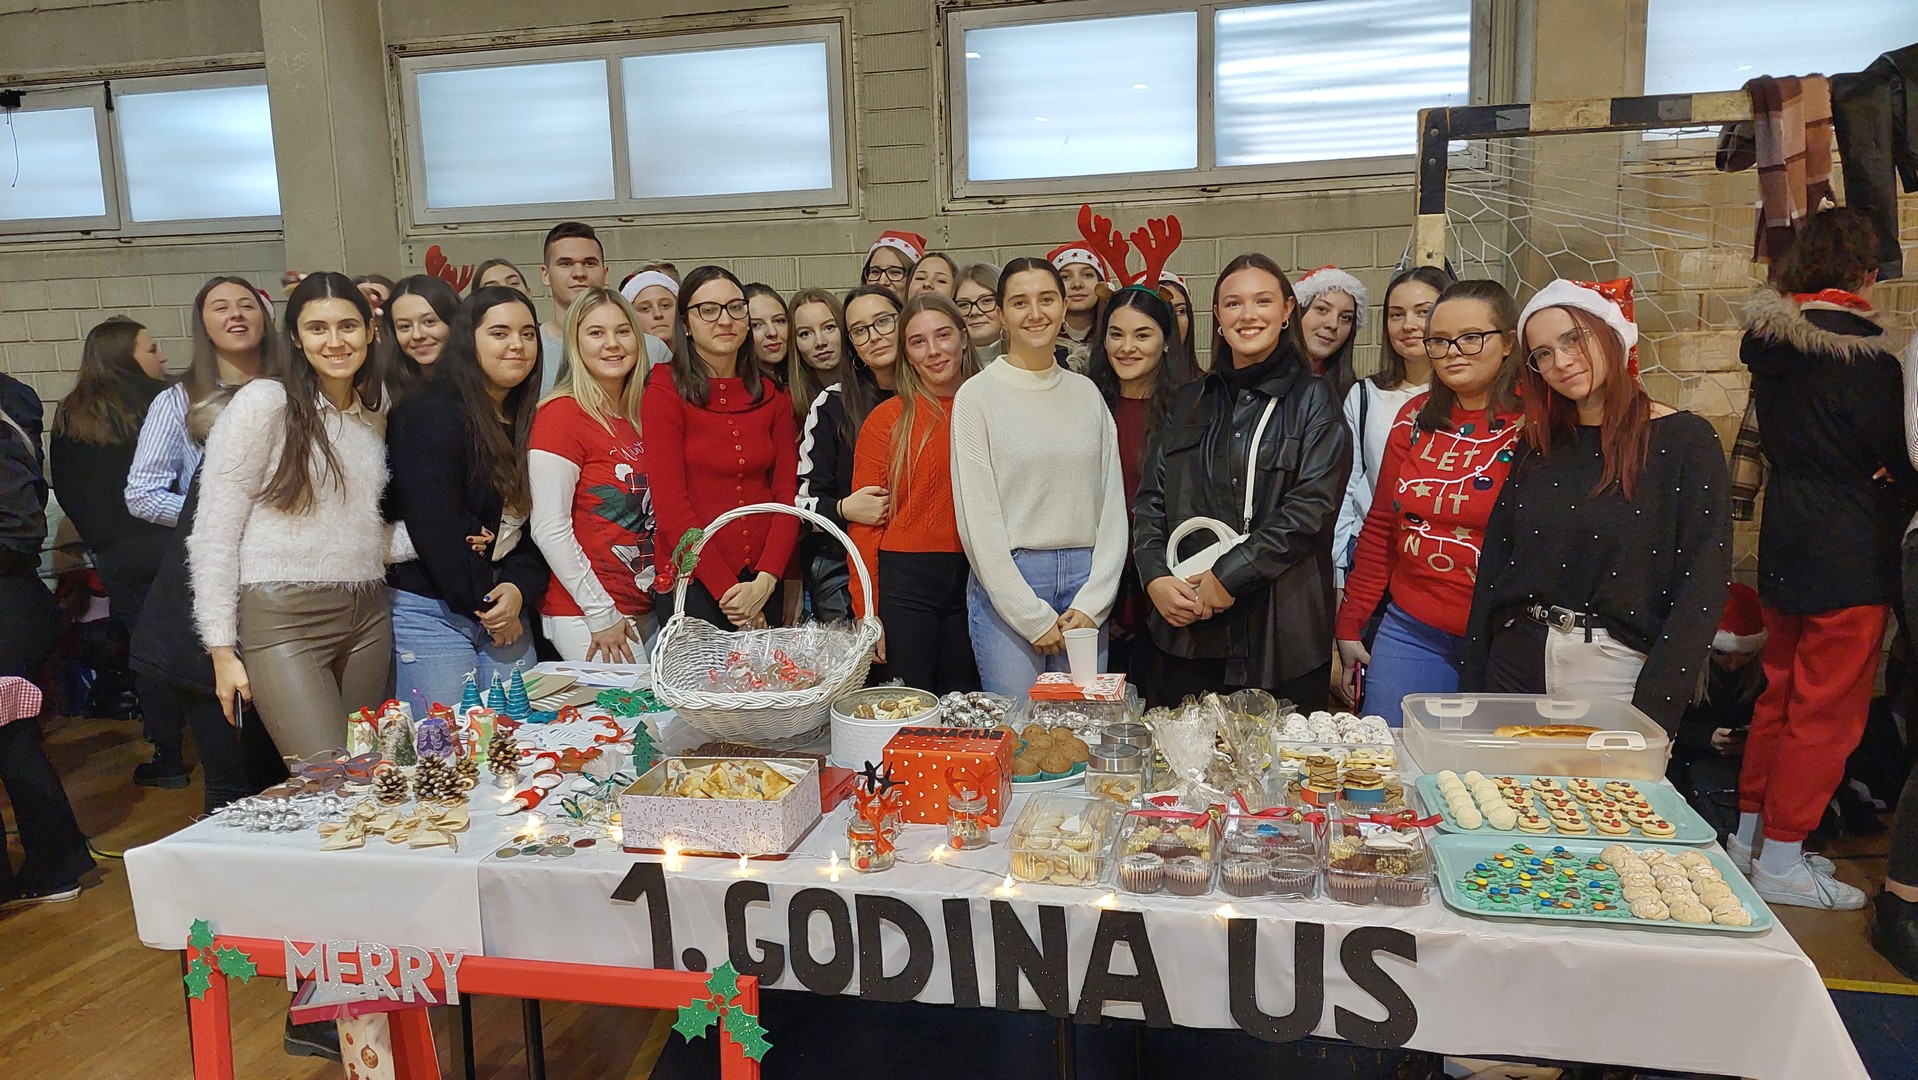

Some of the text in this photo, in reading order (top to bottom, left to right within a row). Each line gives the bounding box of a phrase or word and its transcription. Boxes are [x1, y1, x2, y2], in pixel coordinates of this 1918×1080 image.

[610, 441, 645, 461] Wint
[1420, 443, 1481, 472] LET
[1433, 493, 1470, 515] IT
[897, 728, 1005, 740] DONACIJE
[610, 862, 1418, 1049] 1. GODINA US
[284, 935, 467, 1006] MERRY
